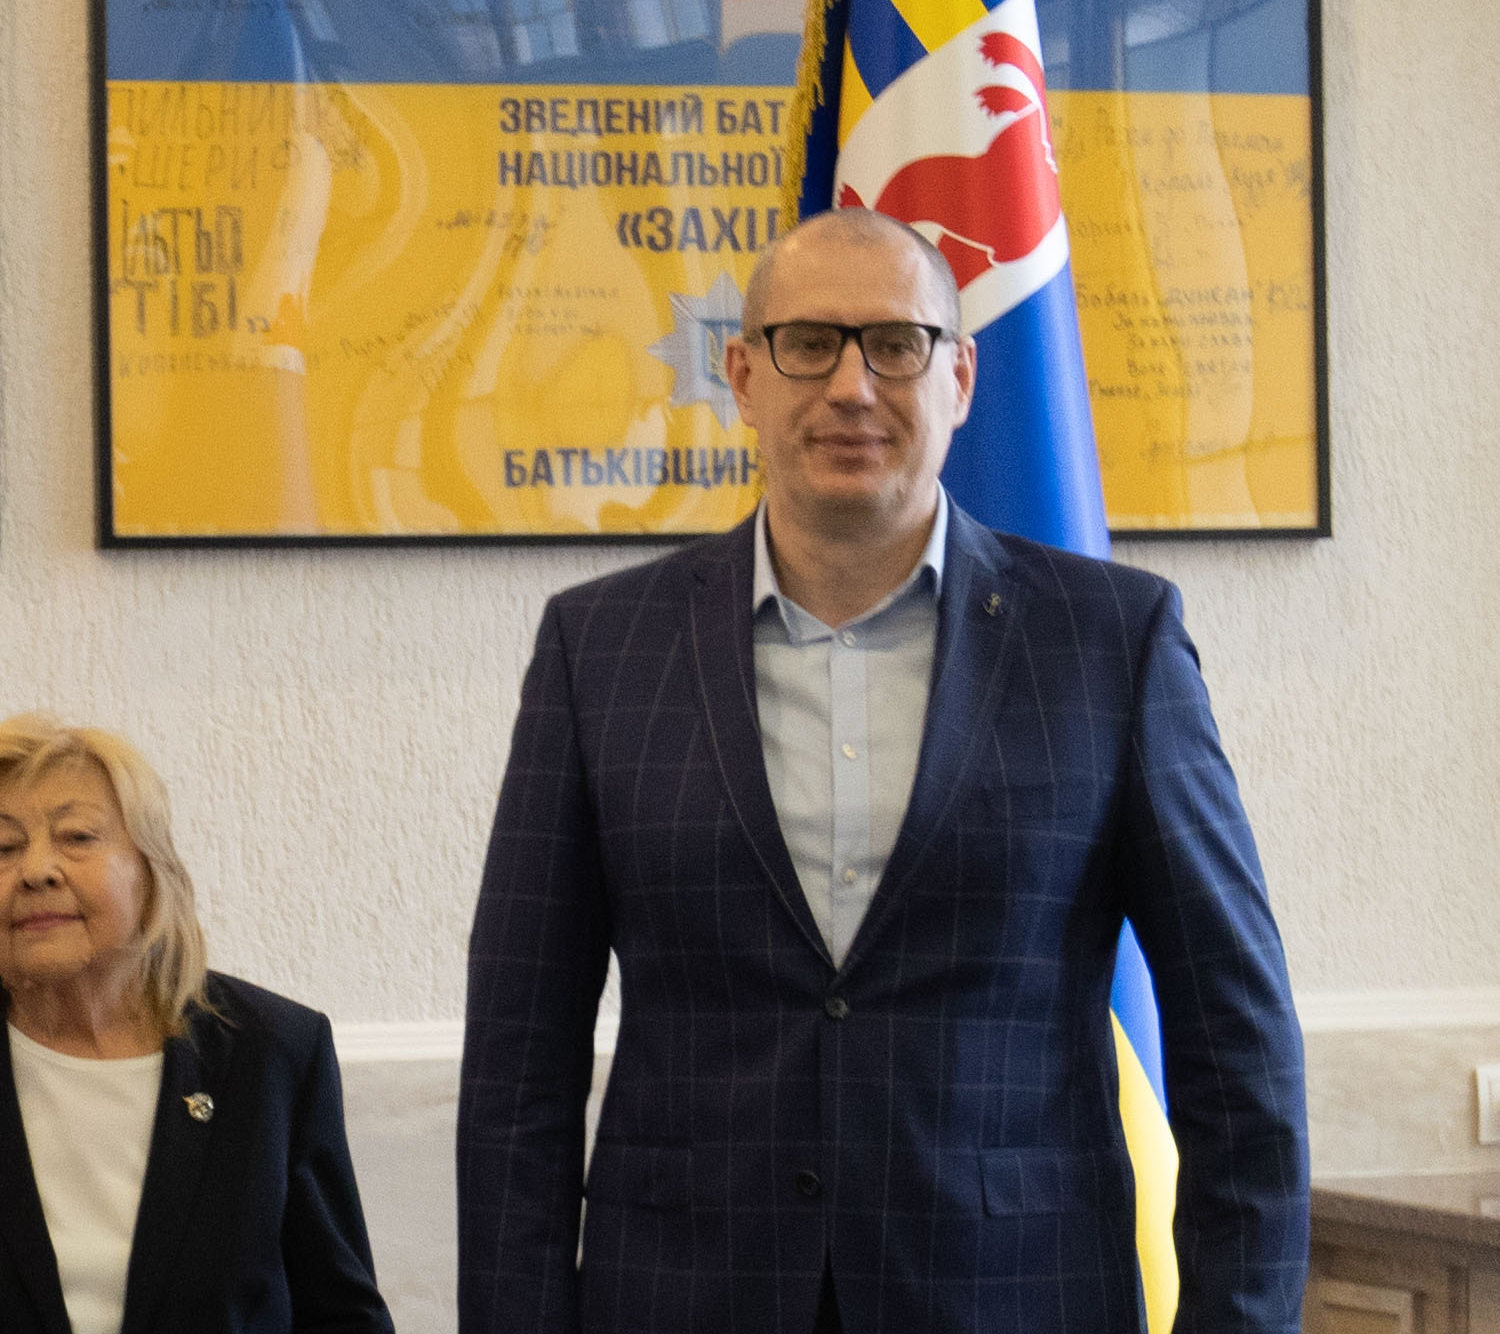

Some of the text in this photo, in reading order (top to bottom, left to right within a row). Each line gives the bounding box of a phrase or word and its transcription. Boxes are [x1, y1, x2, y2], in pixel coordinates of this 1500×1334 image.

[500, 93, 786, 138] ЗВЕДЕНИЙ БАТ
[498, 145, 783, 190] НАЦІОНАЛЬНОЇ
[504, 447, 759, 490] БАТЬКІВЩИН
